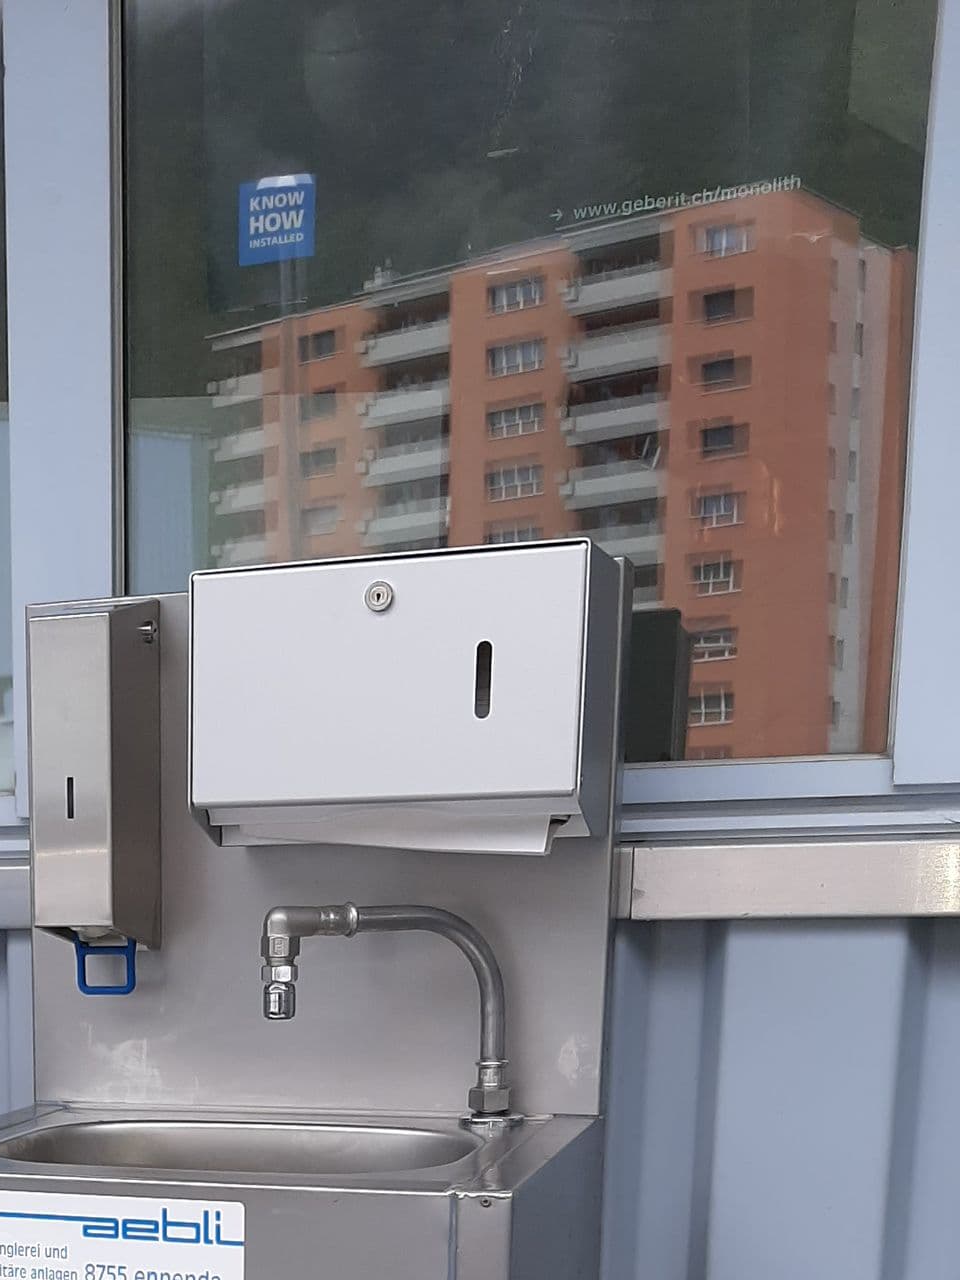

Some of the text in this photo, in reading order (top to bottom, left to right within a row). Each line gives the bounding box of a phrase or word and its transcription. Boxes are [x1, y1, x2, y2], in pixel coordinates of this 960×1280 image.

[249, 191, 305, 212] KNOW
[573, 173, 802, 221] www.geberit.ch/monolith
[249, 209, 305, 235] HOW
[249, 233, 305, 249] INSTALLED
[82, 1208, 244, 1246] aebli
[44, 1246, 68, 1260] und
